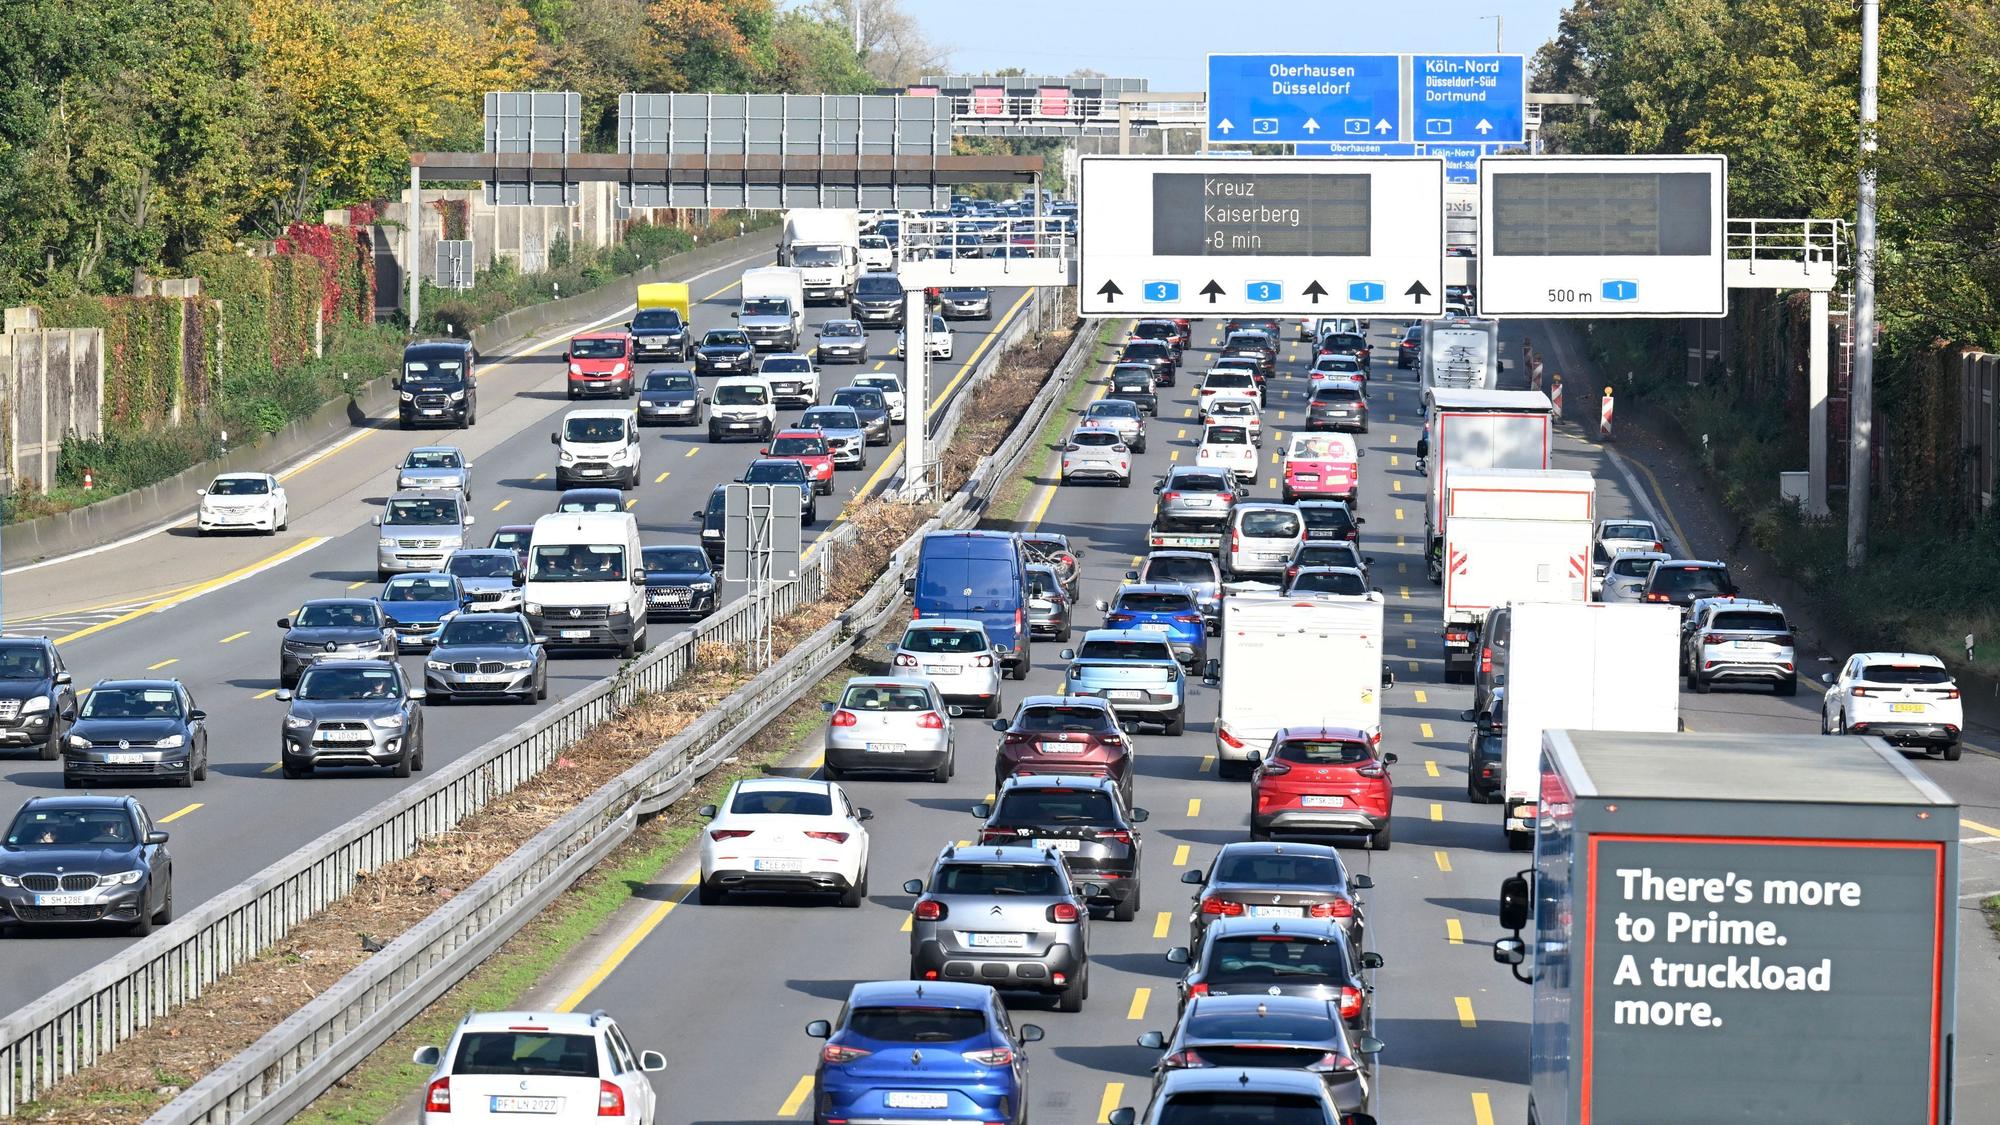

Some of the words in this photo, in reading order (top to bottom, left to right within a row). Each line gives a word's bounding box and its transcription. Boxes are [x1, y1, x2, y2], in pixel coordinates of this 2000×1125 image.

[1270, 64, 1355, 77] Oberhausen
[1426, 60, 1499, 73] Köln-Nord
[1273, 82, 1351, 95] Düsseldorf
[1426, 76, 1496, 87] Düsseldorf-Süd
[1426, 90, 1486, 101] Dortmund
[1330, 144, 1381, 153] Oberhausen
[1204, 178, 1255, 196] Kreuz
[1204, 204, 1299, 227] Kaiserberg
[1205, 231, 1224, 249] +8
[1232, 231, 1261, 249] min
[1157, 284, 1167, 299] 3
[1260, 284, 1269, 299] 3
[1548, 289, 1575, 302] 500
[1579, 292, 1592, 302] m
[1616, 868, 1753, 903] There's
[1763, 880, 1862, 906] more
[1615, 912, 1656, 943] to
[1667, 911, 1788, 946] Prime.
[1613, 954, 1642, 986] A
[1650, 955, 1832, 992] truckload
[1614, 1000, 1723, 1027] more.
